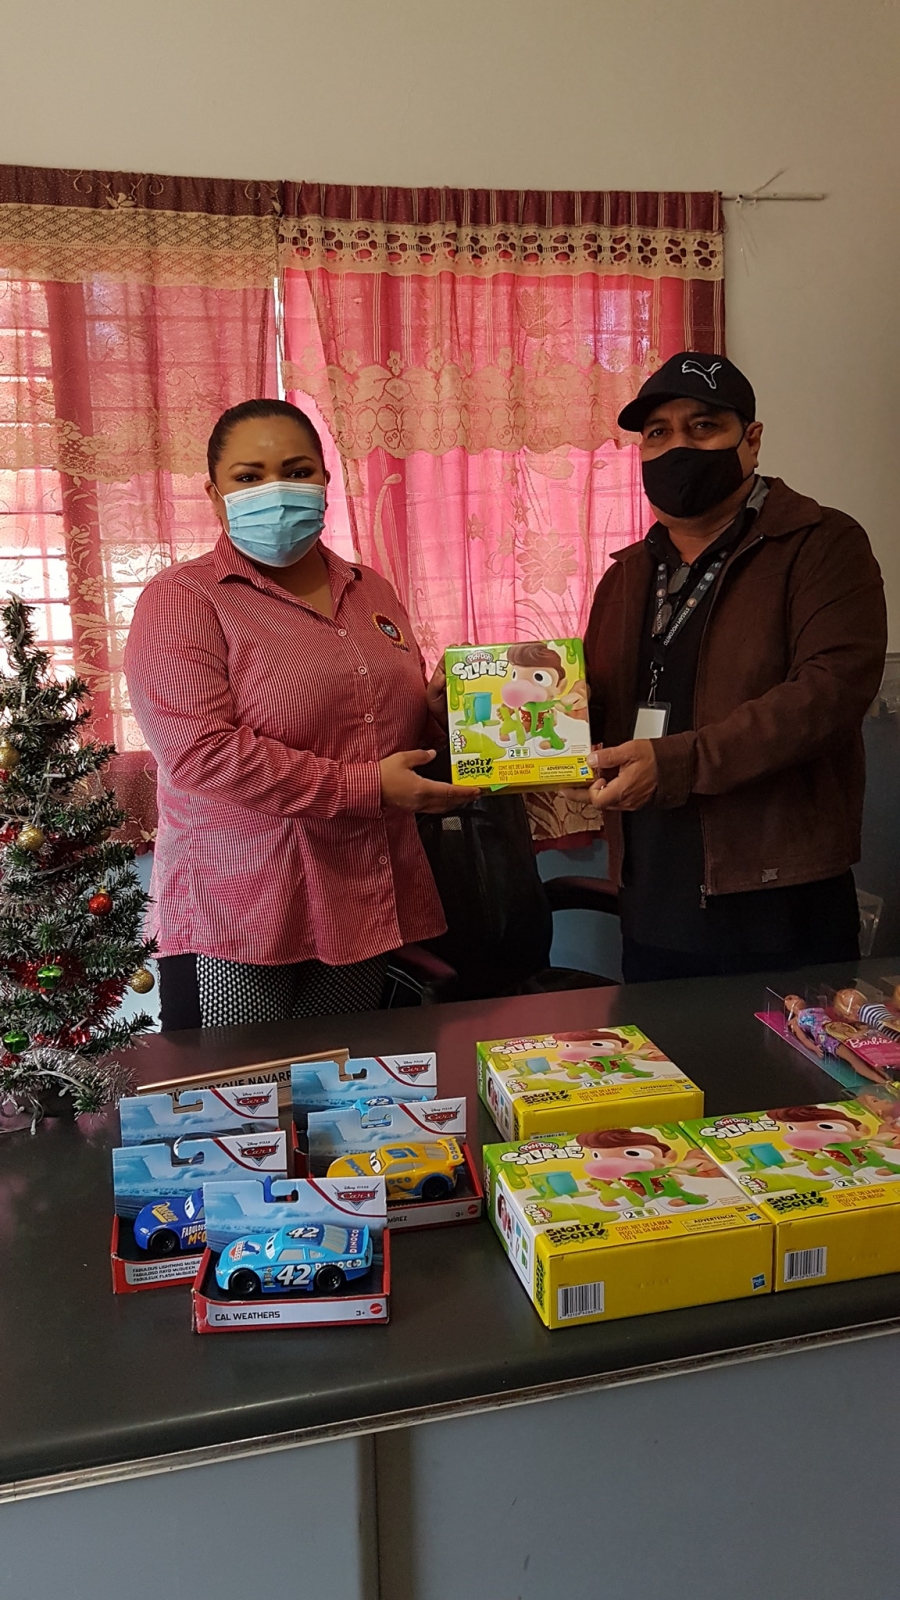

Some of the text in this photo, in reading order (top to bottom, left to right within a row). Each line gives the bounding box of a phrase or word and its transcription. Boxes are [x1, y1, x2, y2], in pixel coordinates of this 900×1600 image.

[451, 660, 509, 681] SLIME
[509, 749, 515, 758] 2
[457, 758, 492, 769] SNOTTY
[458, 766, 493, 776] SCOTTY
[490, 1040, 558, 1054] SLIME
[845, 1036, 892, 1048] Barbie
[699, 1120, 780, 1139] SLIME
[385, 1147, 419, 1159] 51
[500, 1146, 584, 1165] SLIME
[766, 1191, 818, 1206] SNOTTY
[773, 1196, 824, 1211] SCOTTY
[181, 1223, 206, 1239] FABULOUS
[287, 1227, 320, 1239] 42
[546, 1222, 600, 1237] SNOTTY
[550, 1229, 606, 1243] SCOTTY
[349, 1229, 359, 1253] DINOCO
[276, 1263, 311, 1286] 42
[215, 1311, 280, 1321] CAL WEATHERS
